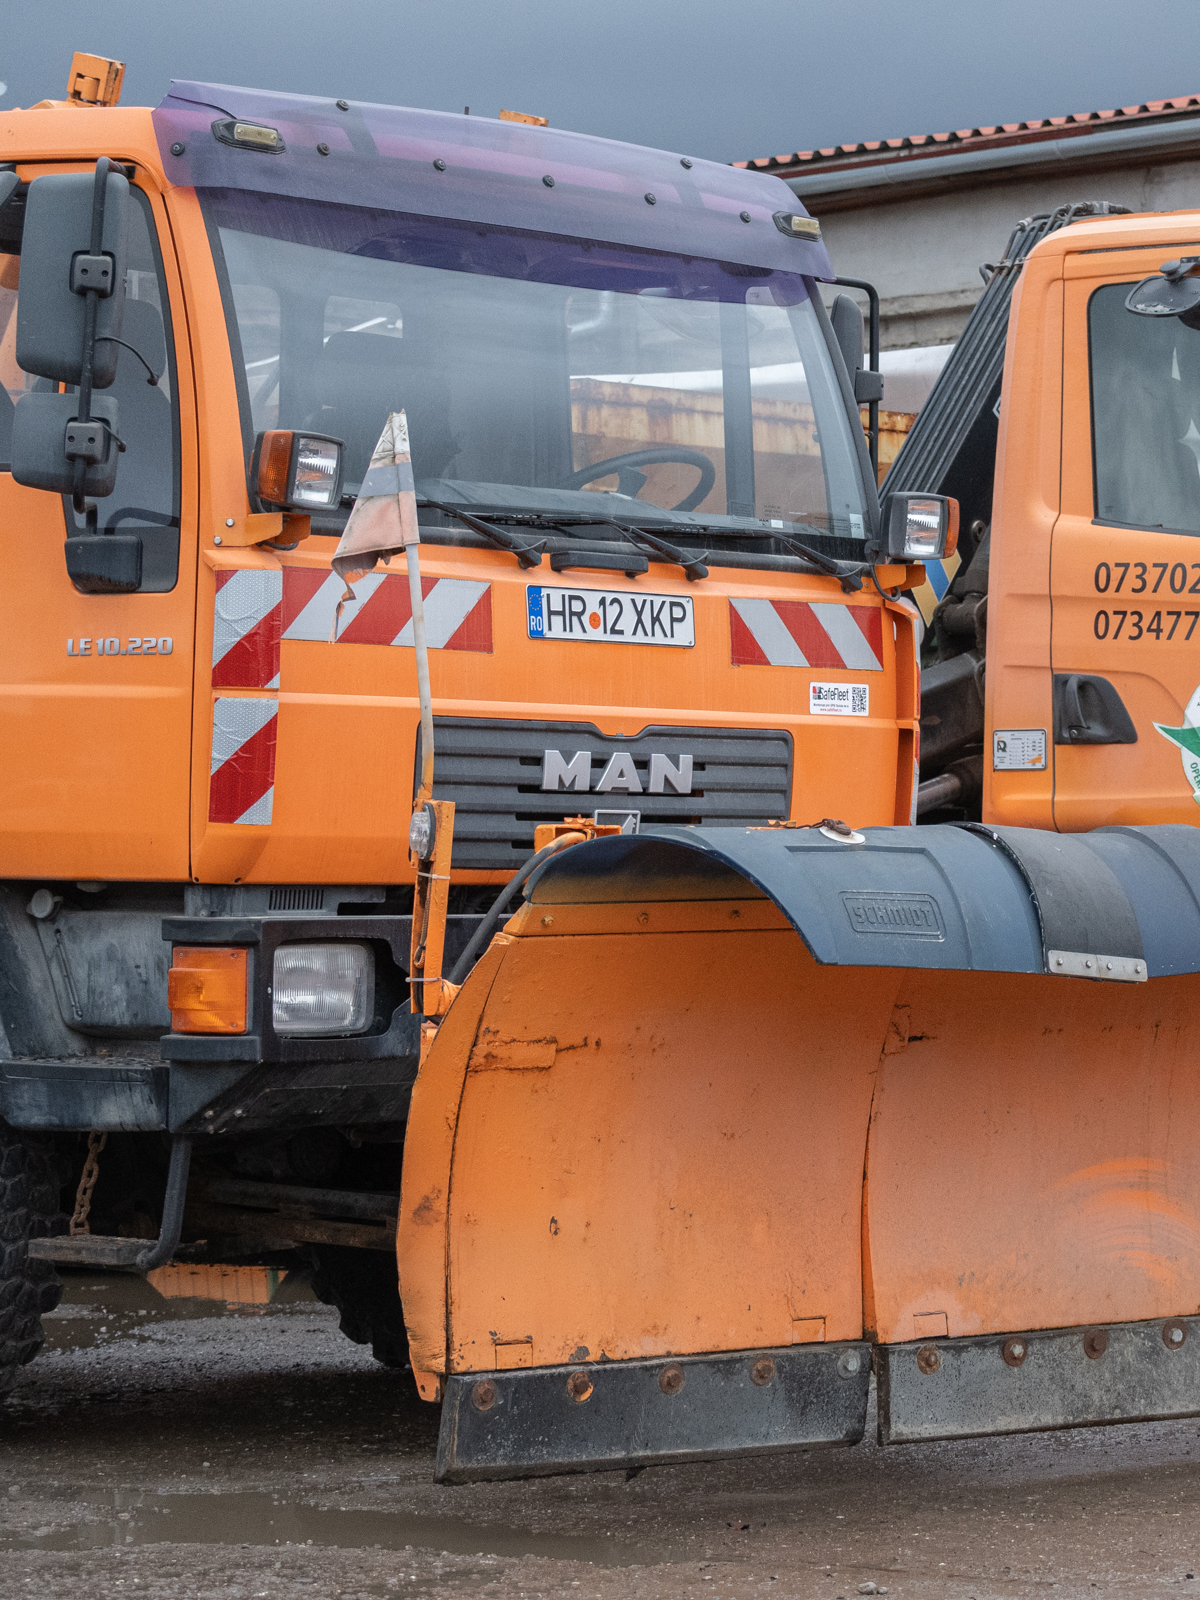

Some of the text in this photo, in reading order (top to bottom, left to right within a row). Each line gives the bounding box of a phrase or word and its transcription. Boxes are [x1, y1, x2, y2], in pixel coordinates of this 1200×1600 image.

[530, 593, 687, 638] RO HR 12 XKP
[67, 637, 173, 656] LE 10.220
[543, 749, 693, 794] MAN
[851, 905, 933, 927] SCHMIDT
